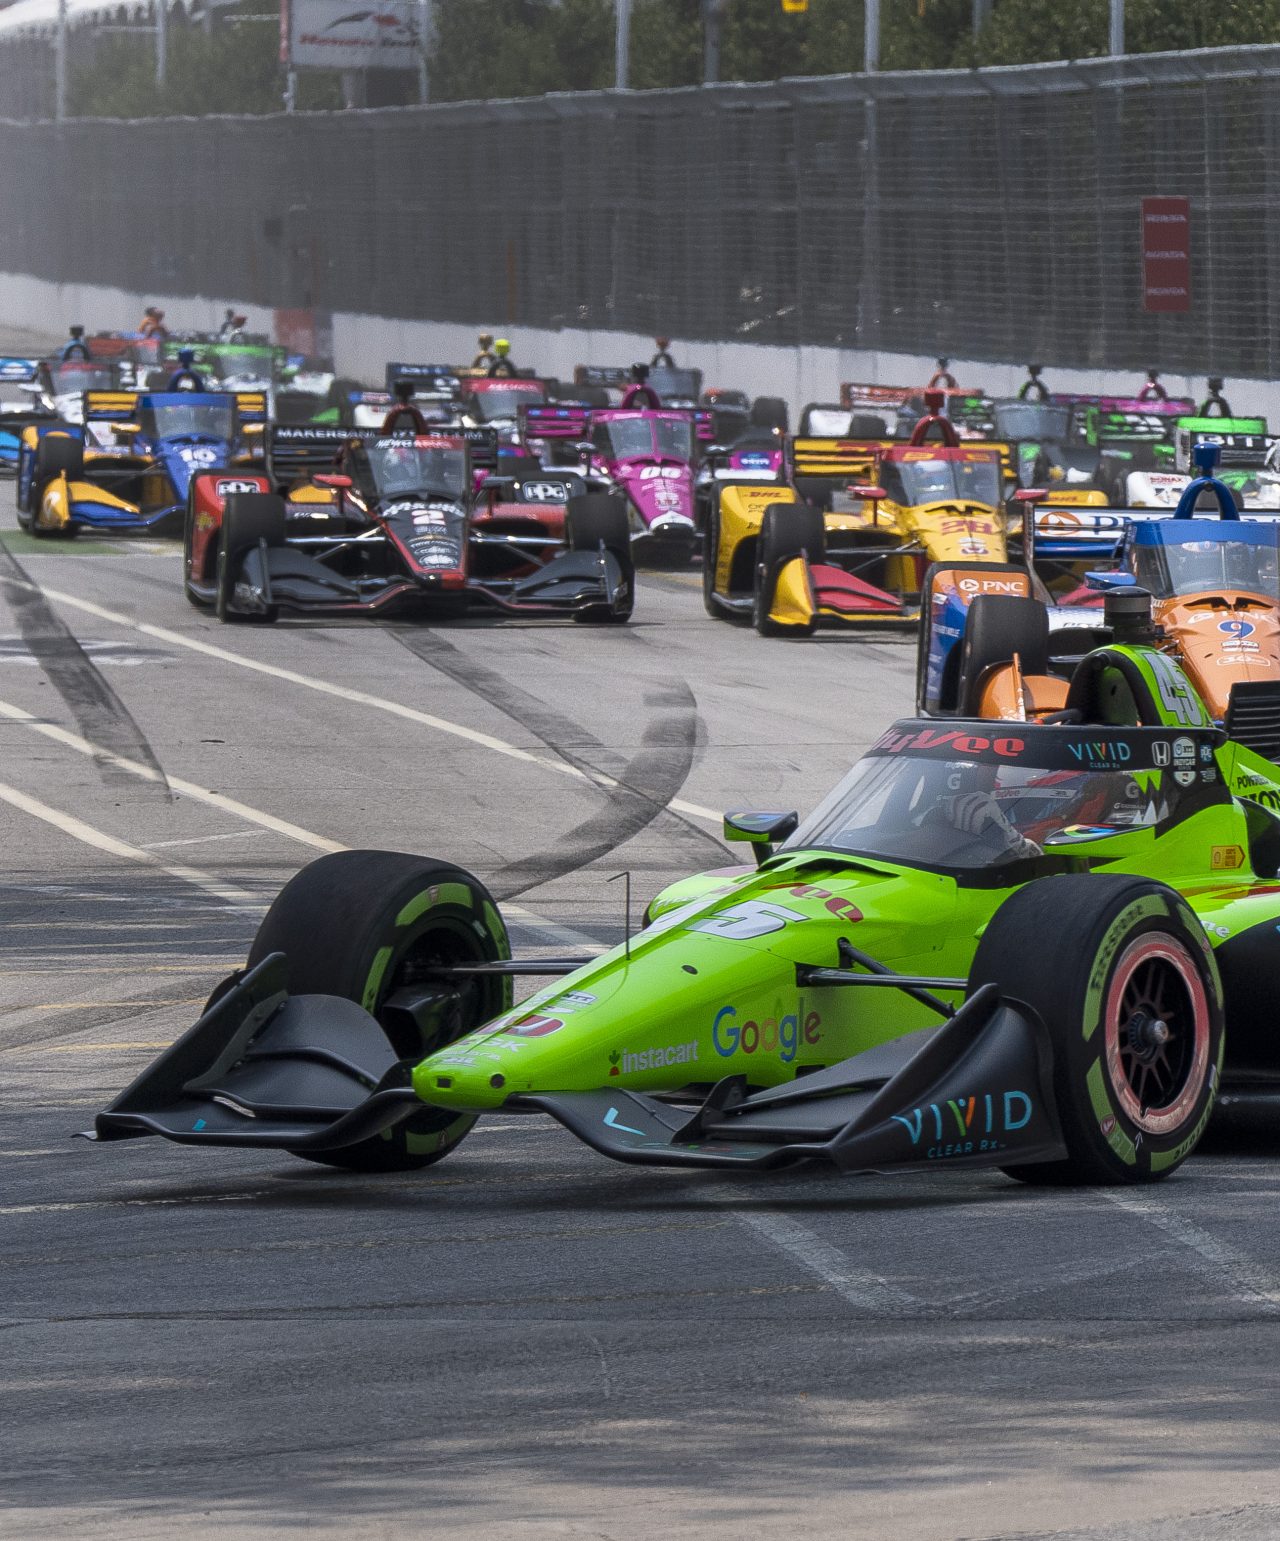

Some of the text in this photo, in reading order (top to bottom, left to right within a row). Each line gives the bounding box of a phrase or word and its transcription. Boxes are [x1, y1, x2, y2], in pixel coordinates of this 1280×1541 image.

[942, 518, 992, 535] 28
[983, 581, 1024, 591] PNC
[1217, 620, 1256, 640] 9
[1067, 742, 1131, 760] VIVID
[713, 1004, 822, 1063] Google
[621, 1039, 699, 1074] instacart
[891, 1090, 1032, 1145] VIVID
[927, 1141, 974, 1160] CLEAR
